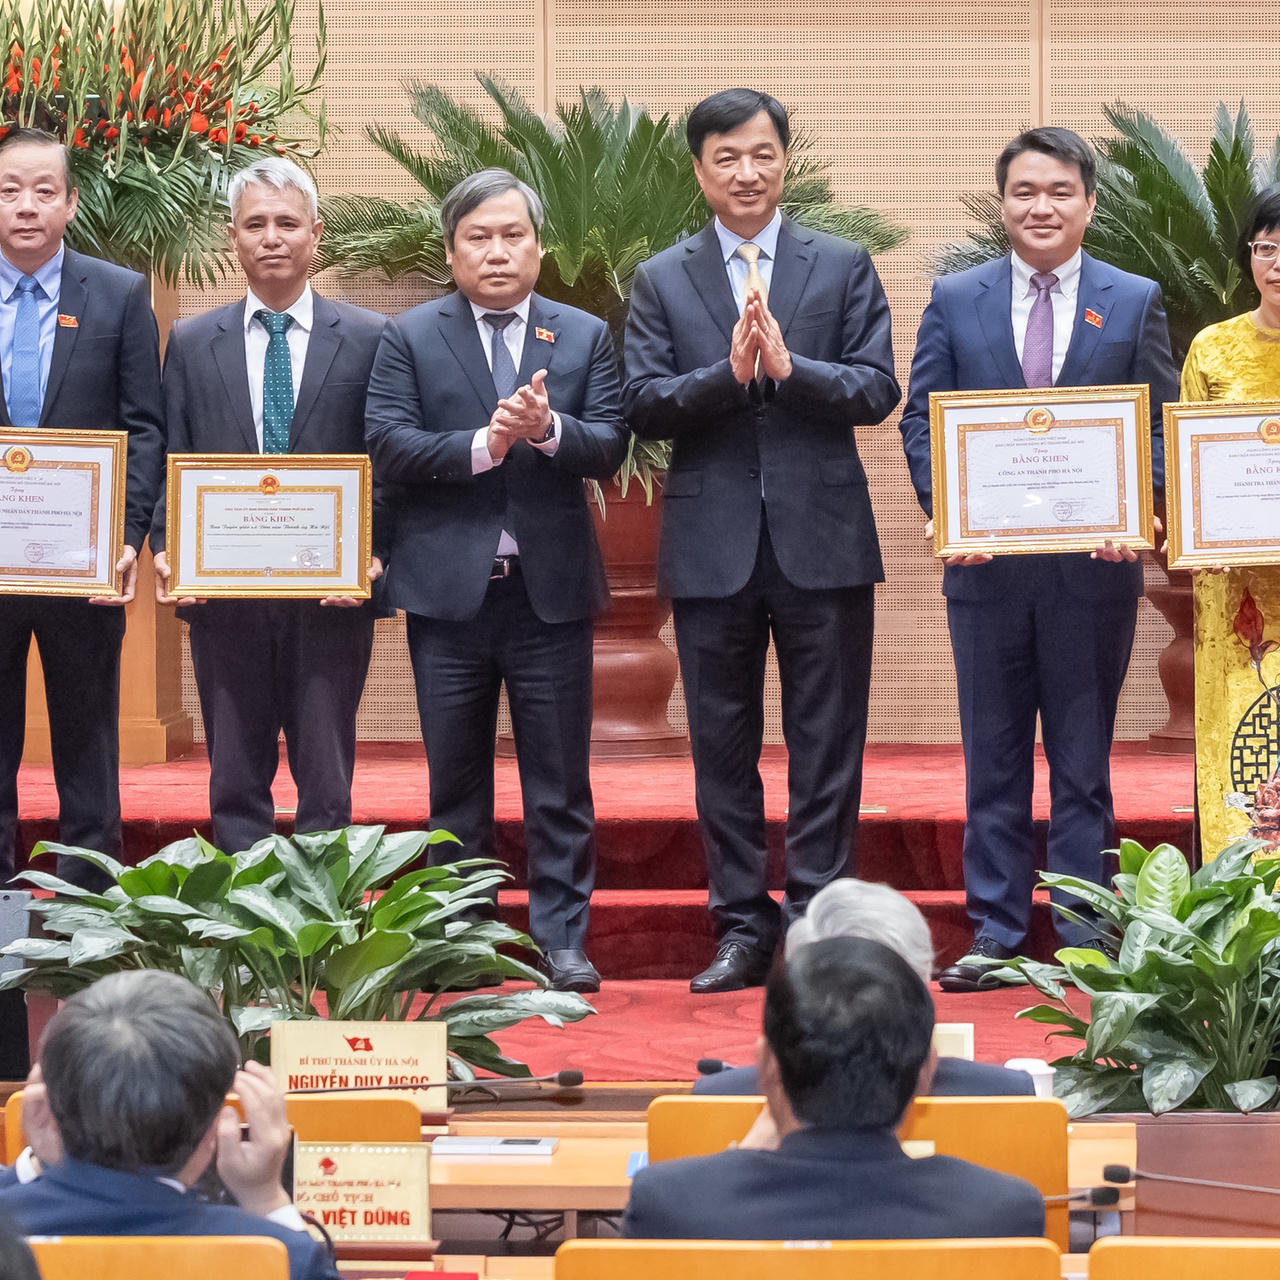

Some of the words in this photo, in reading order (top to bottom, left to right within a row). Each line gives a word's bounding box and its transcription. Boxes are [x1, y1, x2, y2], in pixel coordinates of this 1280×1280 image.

[300, 1056, 308, 1065] BÍ
[312, 1057, 331, 1065] THƯ
[335, 1057, 367, 1066] THÀNH
[370, 1056, 382, 1066] ỦY
[385, 1057, 398, 1066] HÀ
[402, 1056, 418, 1067] NỘI
[288, 1068, 349, 1090] NGUYỄN
[322, 1205, 357, 1228] VIỆT
[364, 1207, 410, 1225] DŨNG
